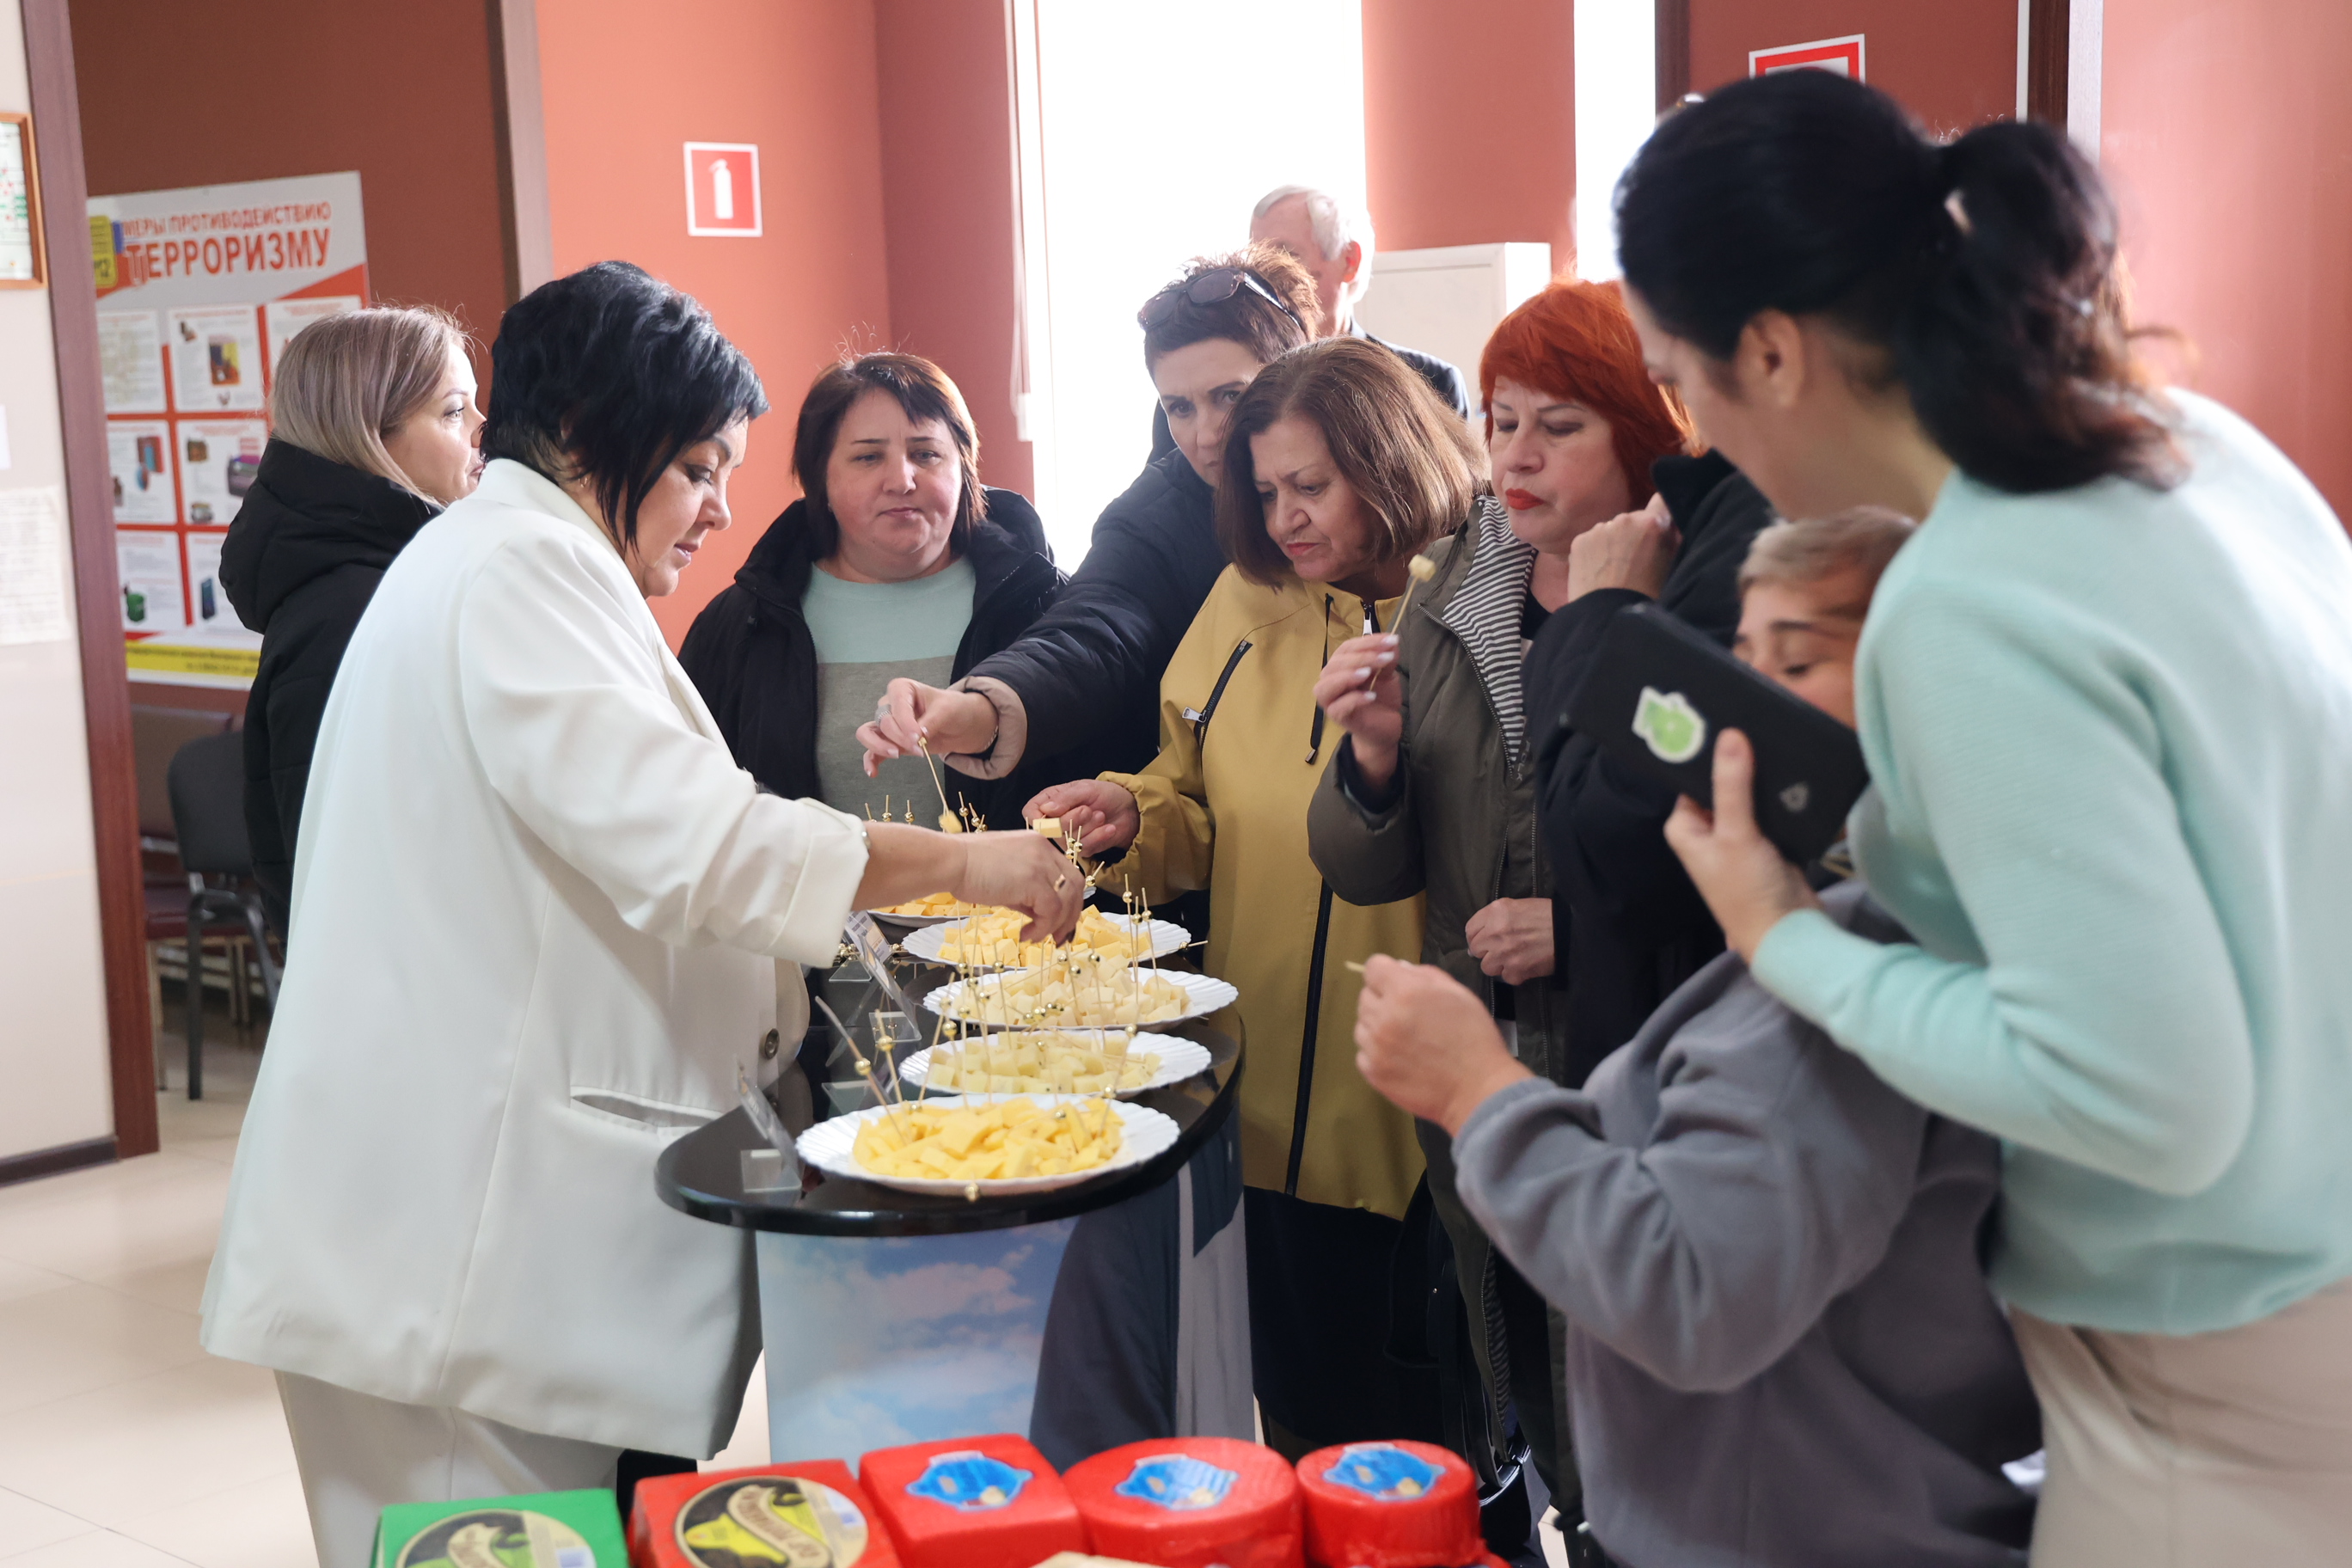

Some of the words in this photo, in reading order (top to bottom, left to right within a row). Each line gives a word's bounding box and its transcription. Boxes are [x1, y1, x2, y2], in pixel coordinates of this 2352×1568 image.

[124, 218, 166, 236] МЕРЫ
[171, 201, 331, 232] ПРОТИВОДЕЙСТВИЮ
[126, 229, 330, 280] ТЕРРОРИЗМУ
